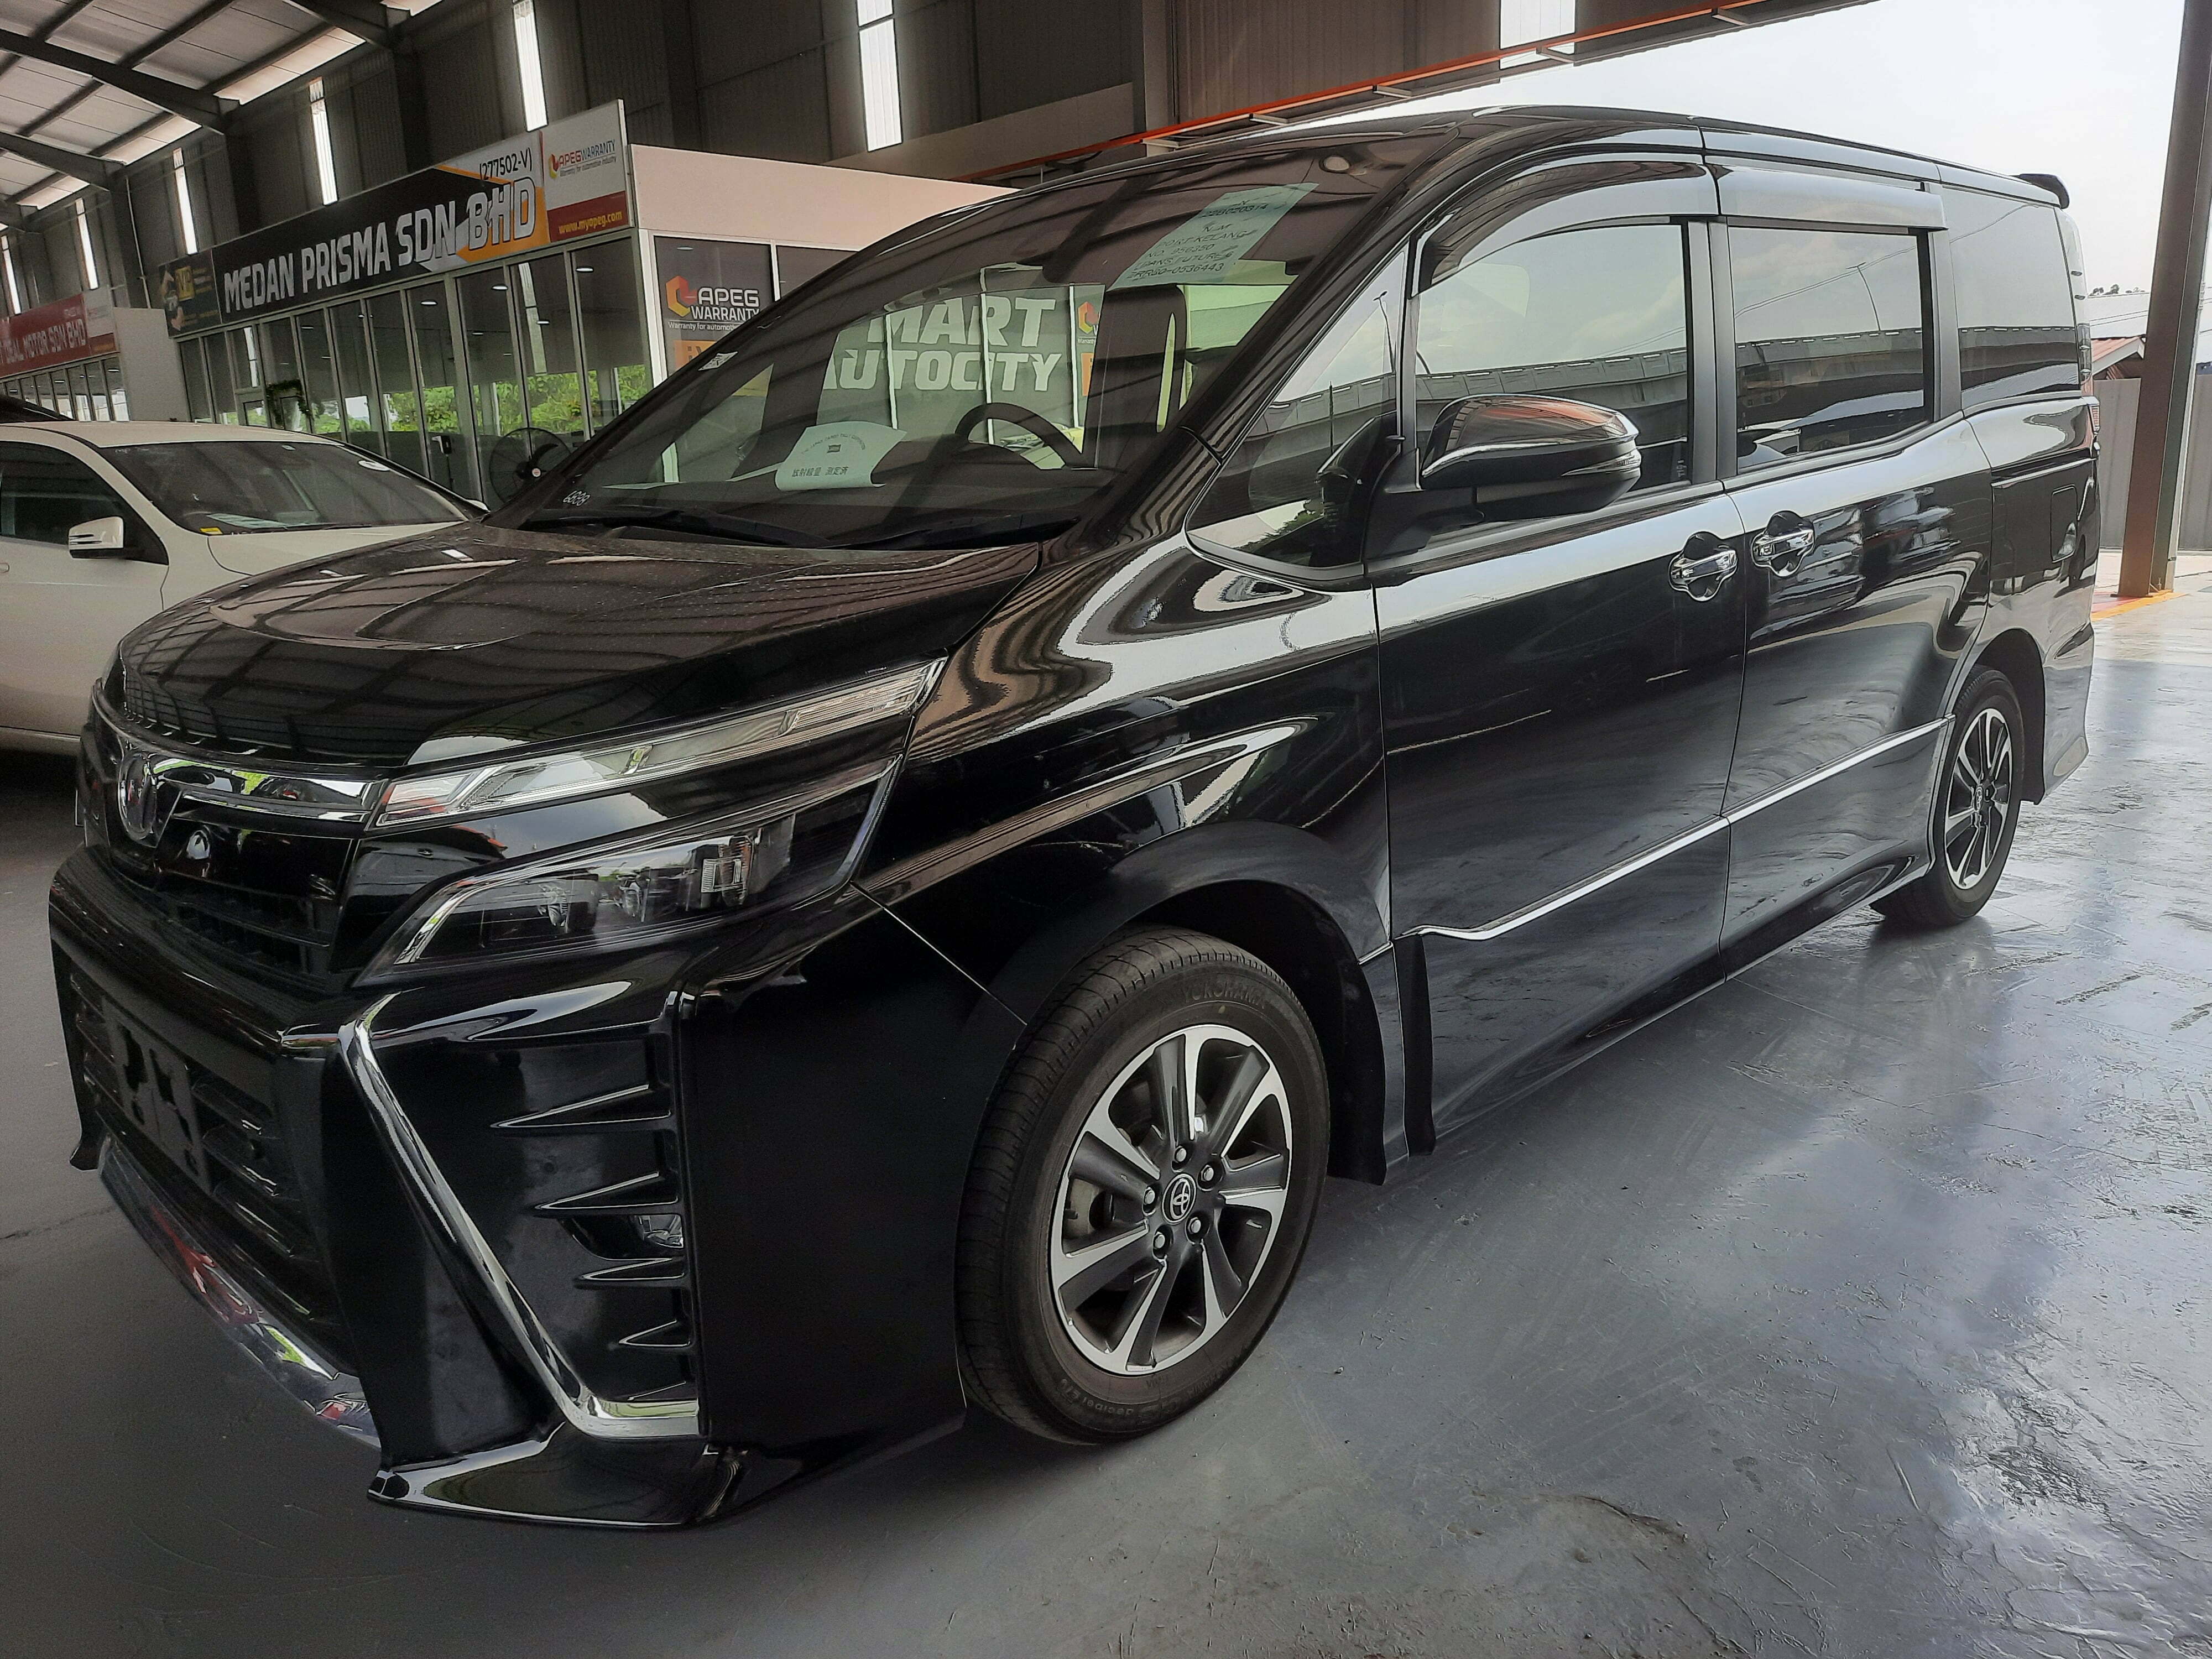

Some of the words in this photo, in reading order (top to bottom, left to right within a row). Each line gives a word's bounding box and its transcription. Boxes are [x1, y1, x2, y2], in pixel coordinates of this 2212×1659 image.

[479, 147, 532, 180] (277502-V)
[224, 252, 295, 314] MEDAN
[301, 222, 391, 294] PRISMA
[395, 201, 456, 267] SDN
[466, 177, 535, 251] BHD
[698, 287, 760, 307] APEG
[668, 321, 696, 331] Warranty
[697, 322, 706, 330] for
[691, 305, 760, 321] WARRANTY
[836, 297, 1056, 347] MART
